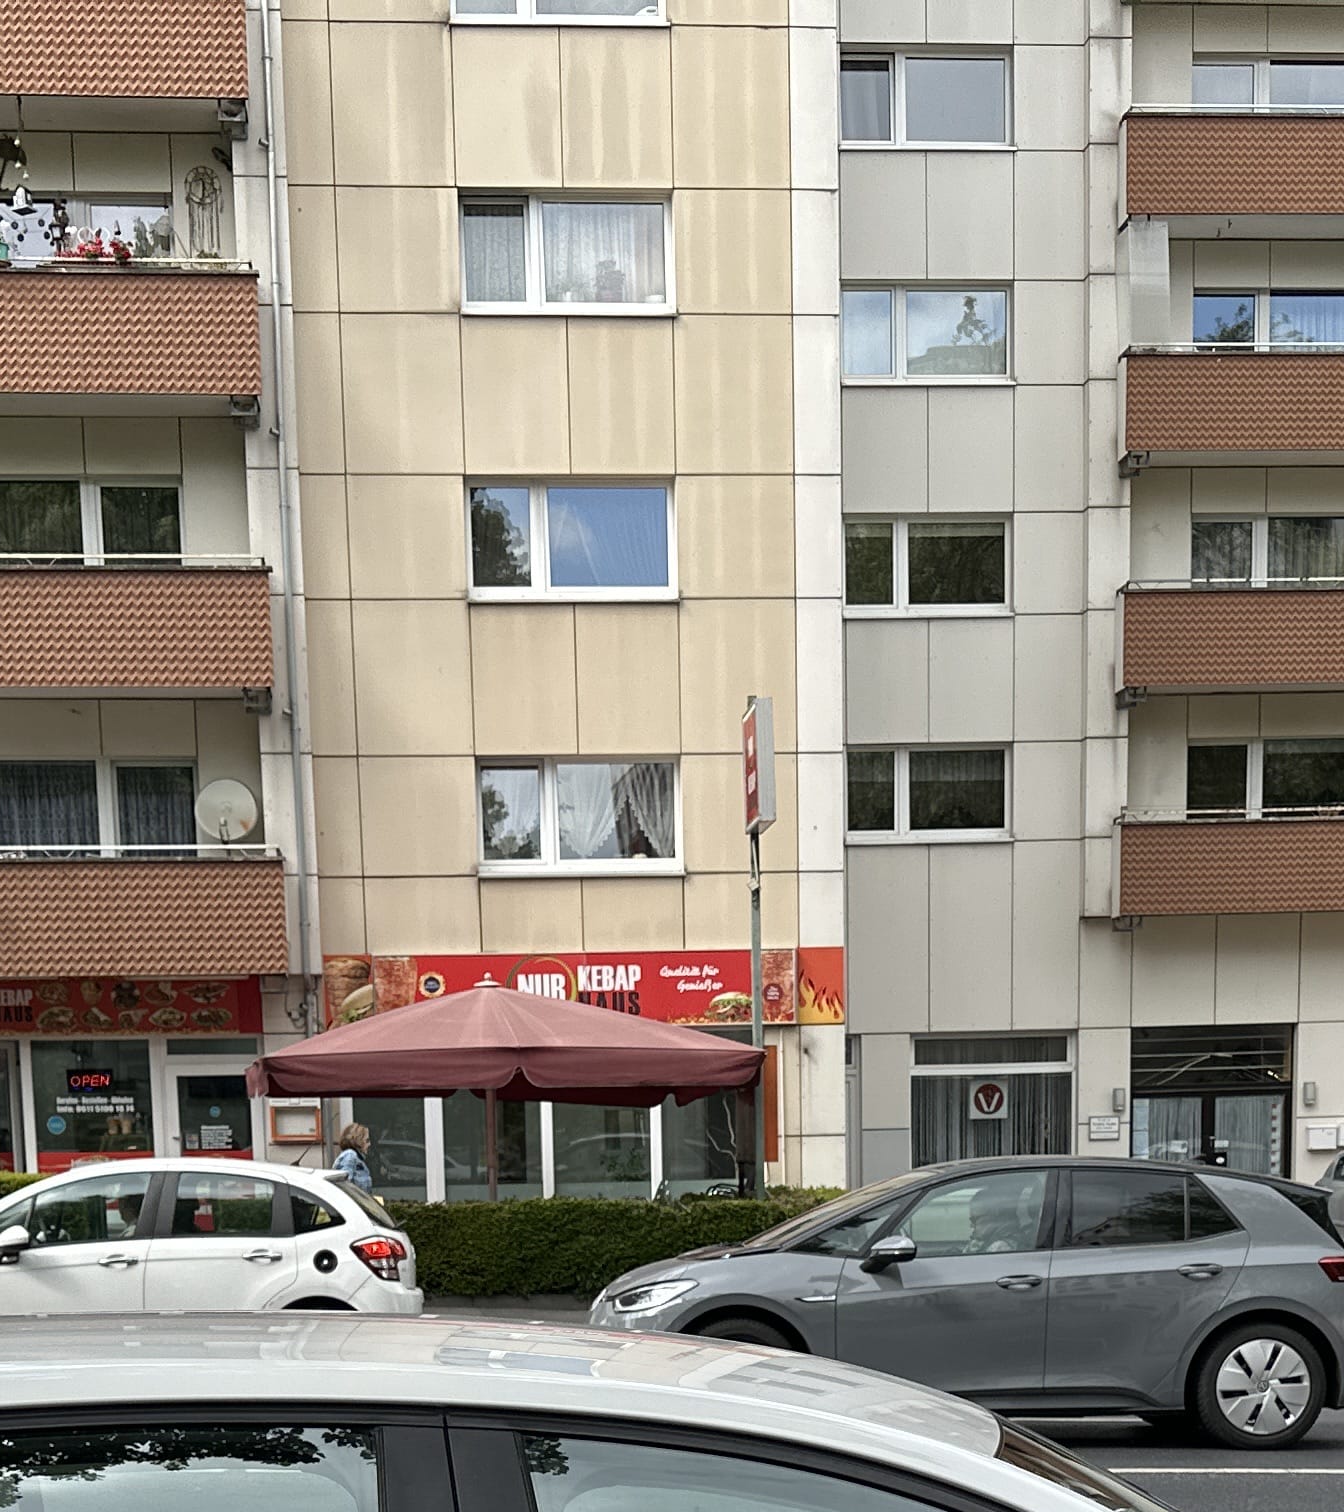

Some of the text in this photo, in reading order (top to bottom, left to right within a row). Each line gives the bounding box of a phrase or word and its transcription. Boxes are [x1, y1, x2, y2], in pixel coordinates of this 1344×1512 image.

[517, 973, 566, 1000] NUR
[577, 965, 641, 992] KEBAP
[71, 1075, 110, 1087] OPEN
[978, 1092, 1000, 1112] V
